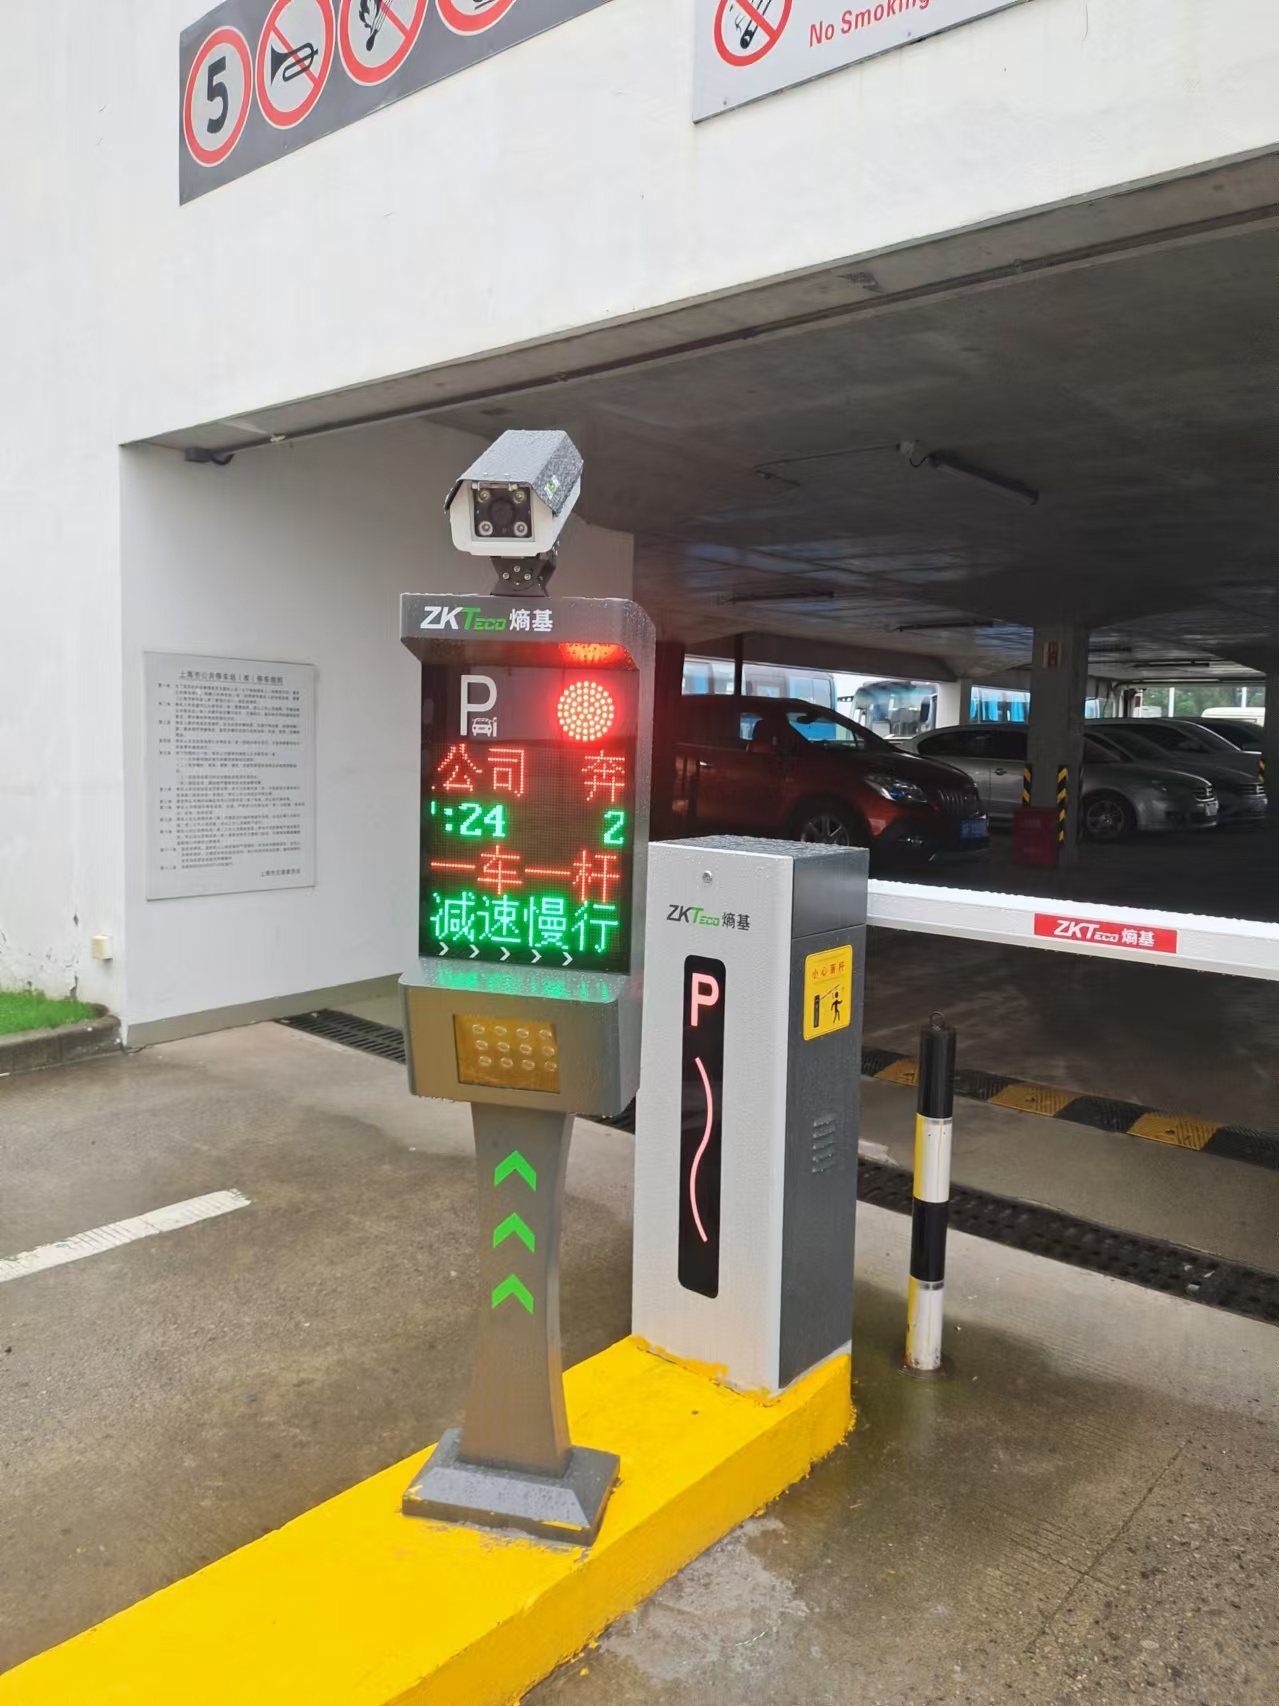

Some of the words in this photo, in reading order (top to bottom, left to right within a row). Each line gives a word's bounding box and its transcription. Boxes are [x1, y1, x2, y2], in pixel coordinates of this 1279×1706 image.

[809, 21, 835, 48] No
[841, 0, 930, 34] Smoking
[207, 56, 228, 134] 5
[509, 608, 554, 633] 熵基
[435, 744, 525, 797] 公司
[581, 750, 626, 802] 奔
[430, 801, 507, 838] :24
[430, 845, 621, 903] 一车一杆
[430, 892, 620, 953] 减速慢行
[721, 912, 751, 931] 熵基
[1121, 928, 1156, 947] 熵基
[690, 972, 720, 1027] P
